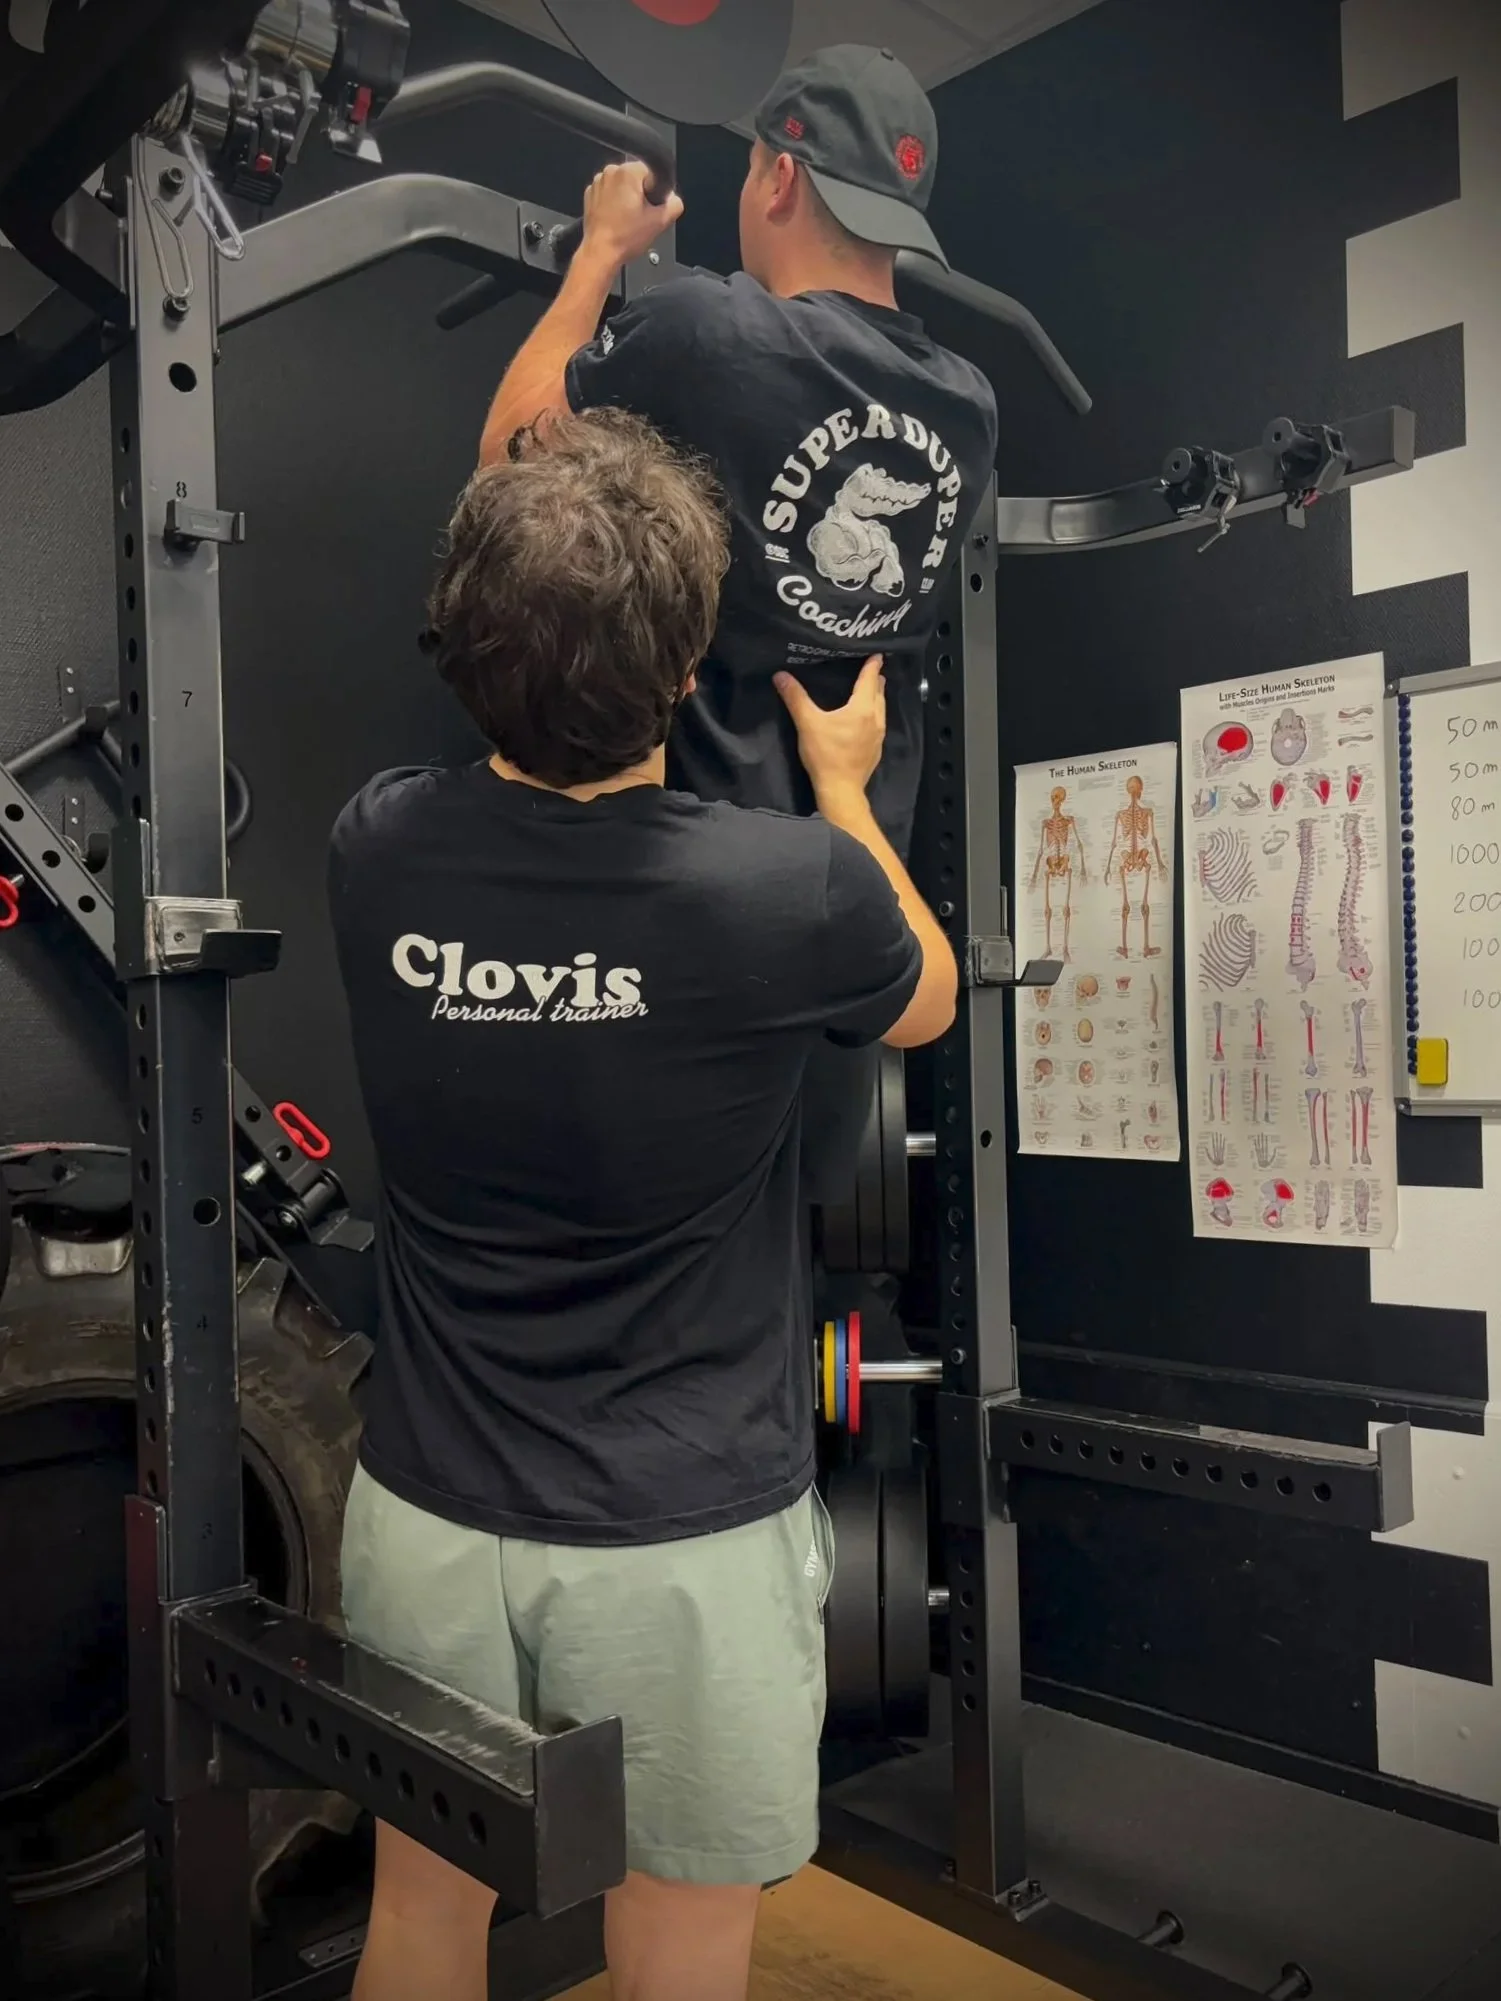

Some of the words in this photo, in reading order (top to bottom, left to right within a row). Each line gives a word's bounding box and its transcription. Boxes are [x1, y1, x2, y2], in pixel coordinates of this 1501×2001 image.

[176, 481, 187, 498] 8
[777, 575, 912, 638] Coaching
[181, 690, 193, 708] 7
[1232, 700, 1254, 709] Muscles
[1255, 696, 1275, 705] Origins
[1276, 693, 1287, 701] and
[1287, 689, 1316, 699] Insertions
[1317, 685, 1335, 694] Marks
[1447, 715, 1477, 745] 50
[1482, 720, 1499, 732] m
[1449, 762, 1479, 783] 50
[1482, 763, 1498, 774] m
[1451, 795, 1475, 821] 80
[1481, 802, 1495, 812] m
[1450, 842, 1500, 865] 1000
[1463, 937, 1500, 960] 100
[392, 933, 642, 1008] Clovis
[431, 994, 544, 1022] Personal
[550, 997, 649, 1022] trainer
[192, 1107, 203, 1125] 5
[197, 1314, 208, 1332] 4
